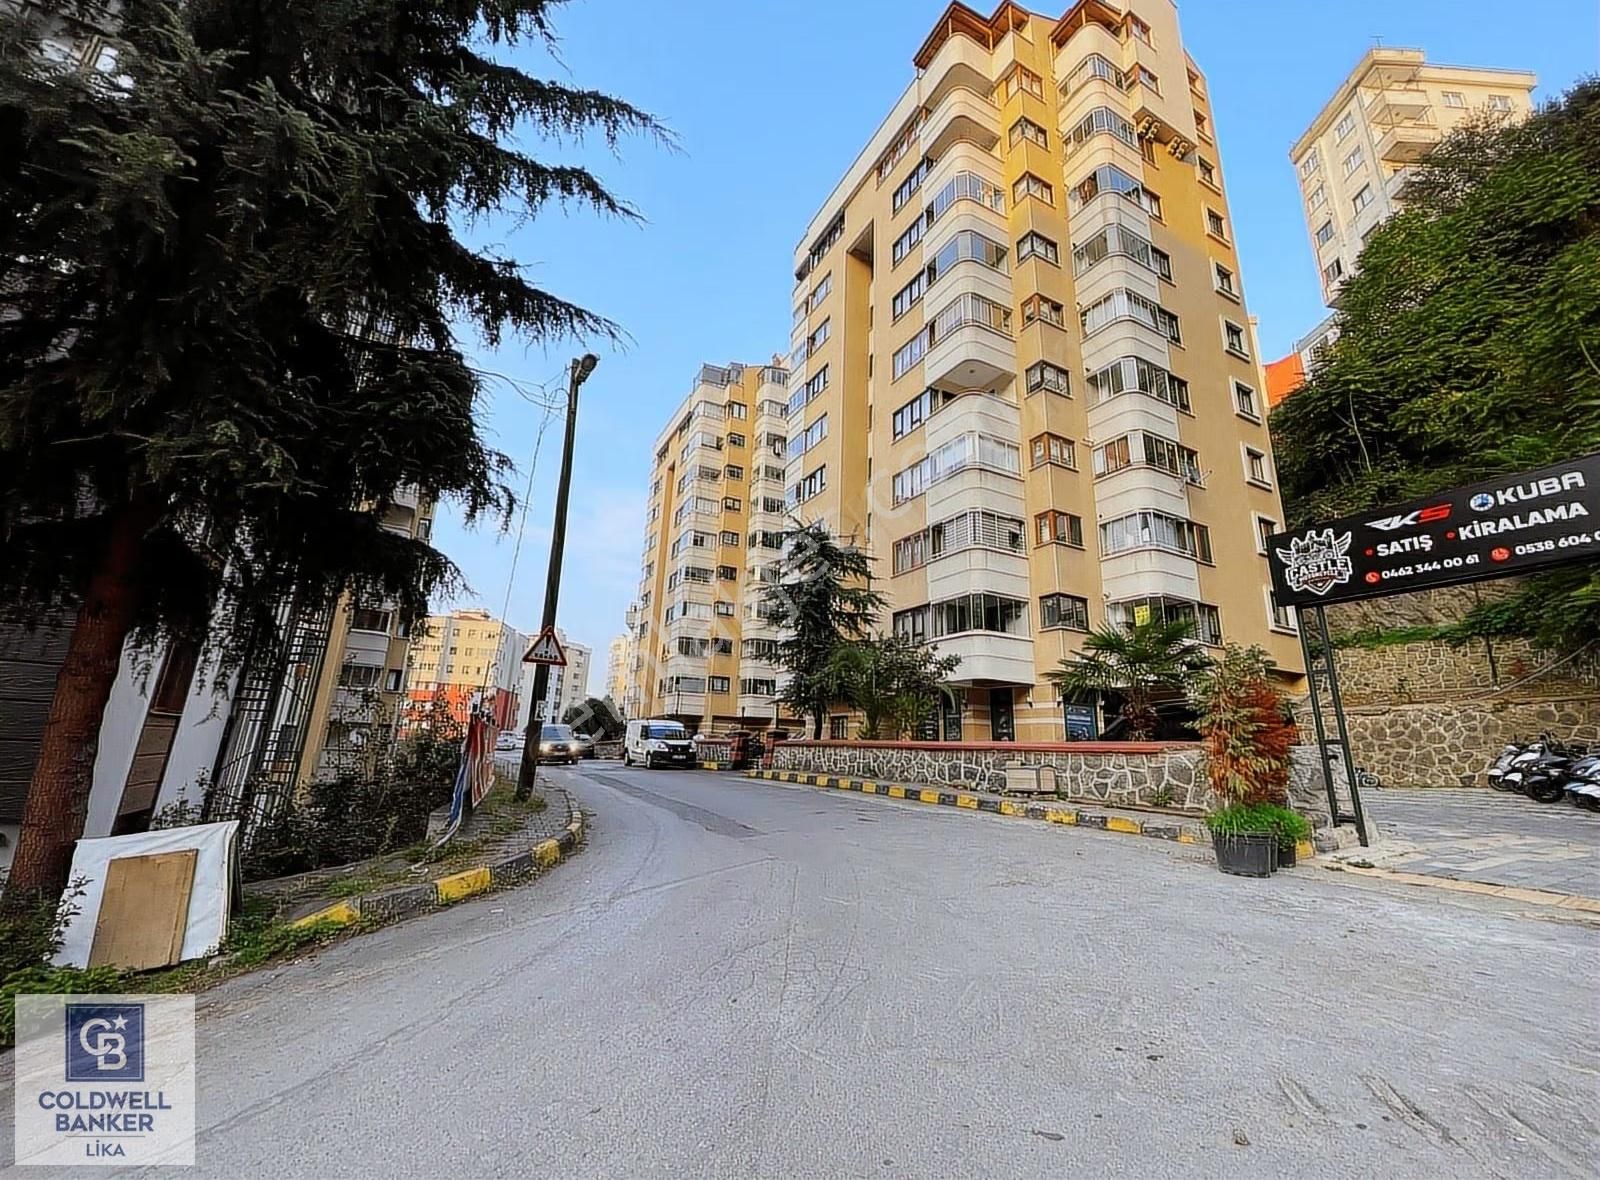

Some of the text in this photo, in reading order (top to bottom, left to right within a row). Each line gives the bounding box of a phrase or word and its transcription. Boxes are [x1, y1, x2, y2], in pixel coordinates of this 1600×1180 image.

[1496, 471, 1586, 506] KUBA
[1458, 502, 1589, 541] KİRALAMA
[1376, 535, 1433, 557] SATIŞ
[1514, 540, 1555, 555] 0538
[1558, 533, 1591, 547] 604
[1290, 559, 1348, 581] CASTLE
[1381, 554, 1480, 579] 0462 344 00 61
